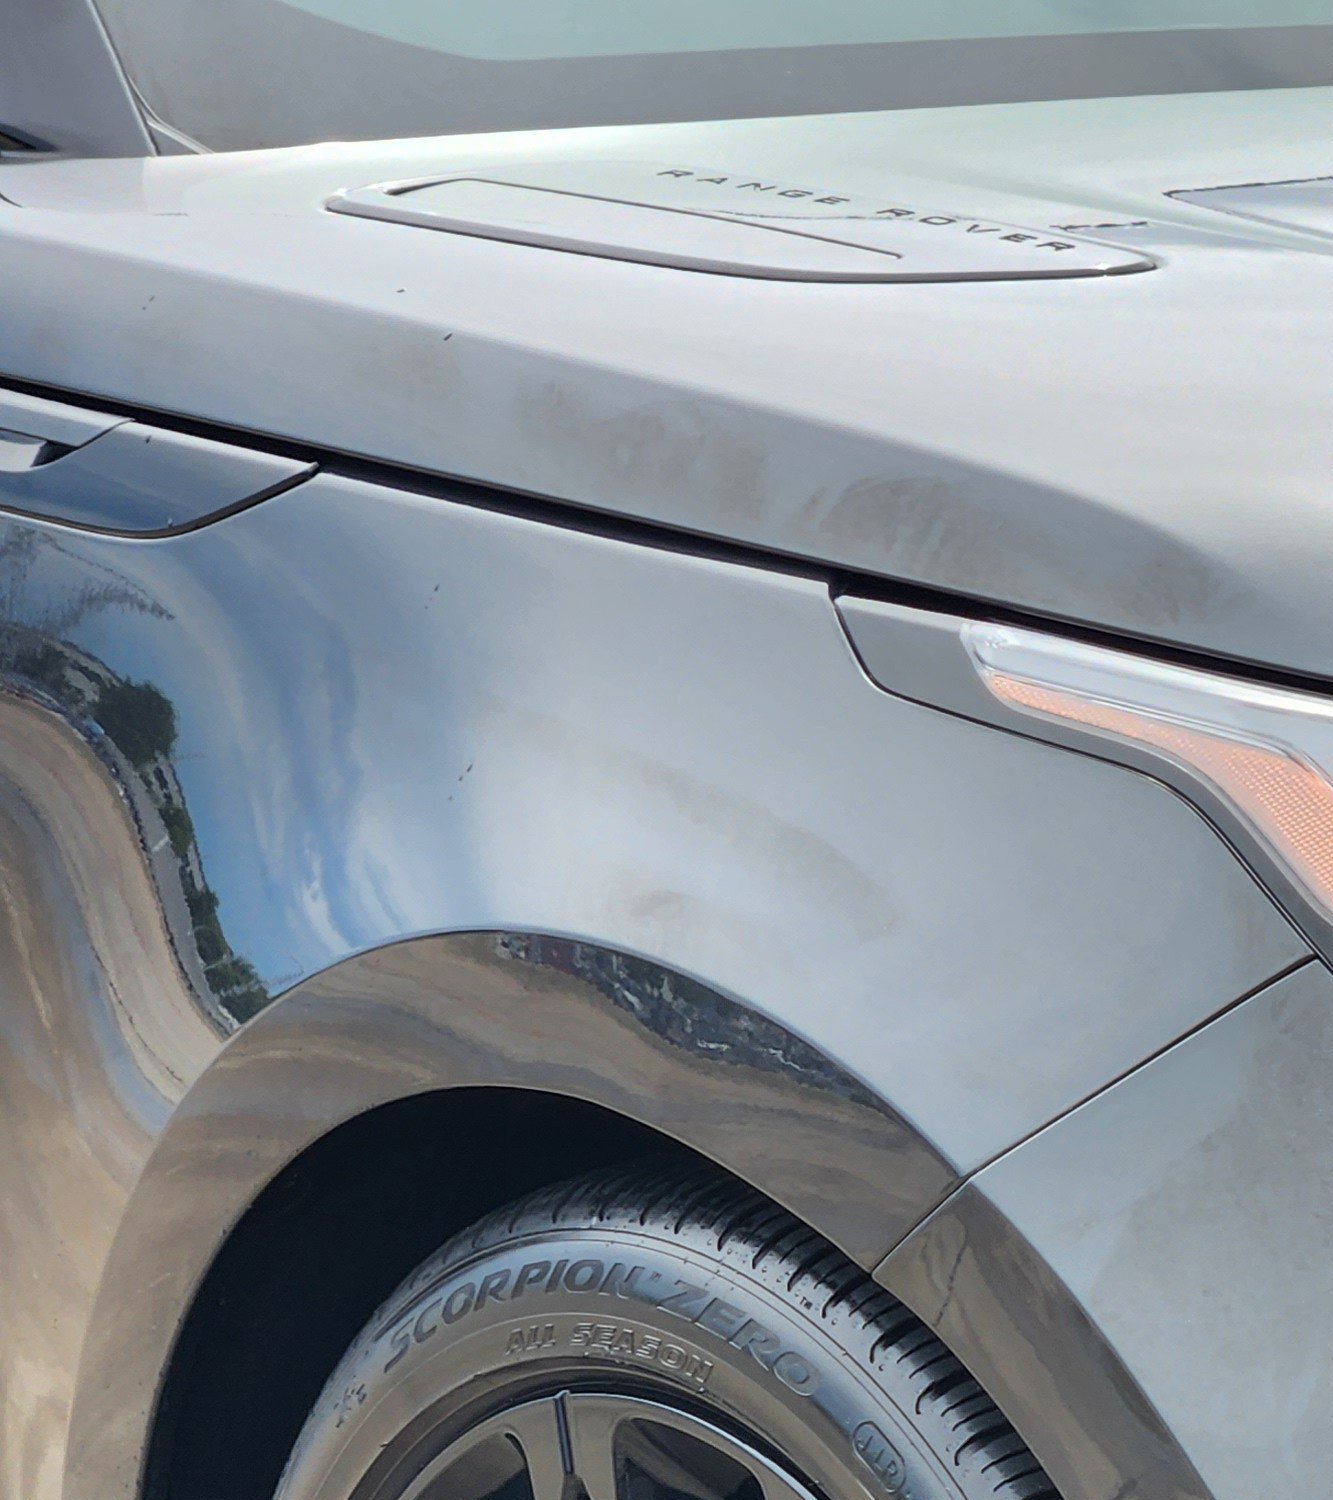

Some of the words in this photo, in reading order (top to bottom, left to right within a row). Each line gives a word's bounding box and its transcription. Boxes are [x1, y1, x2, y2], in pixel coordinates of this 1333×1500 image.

[657, 169, 851, 204] RANGE
[876, 208, 1076, 252] ROVER
[382, 1259, 648, 1373] SCORPION
[656, 1278, 819, 1397] ZERO
[503, 1323, 556, 1356] ALL
[570, 1321, 713, 1386] SEASON
